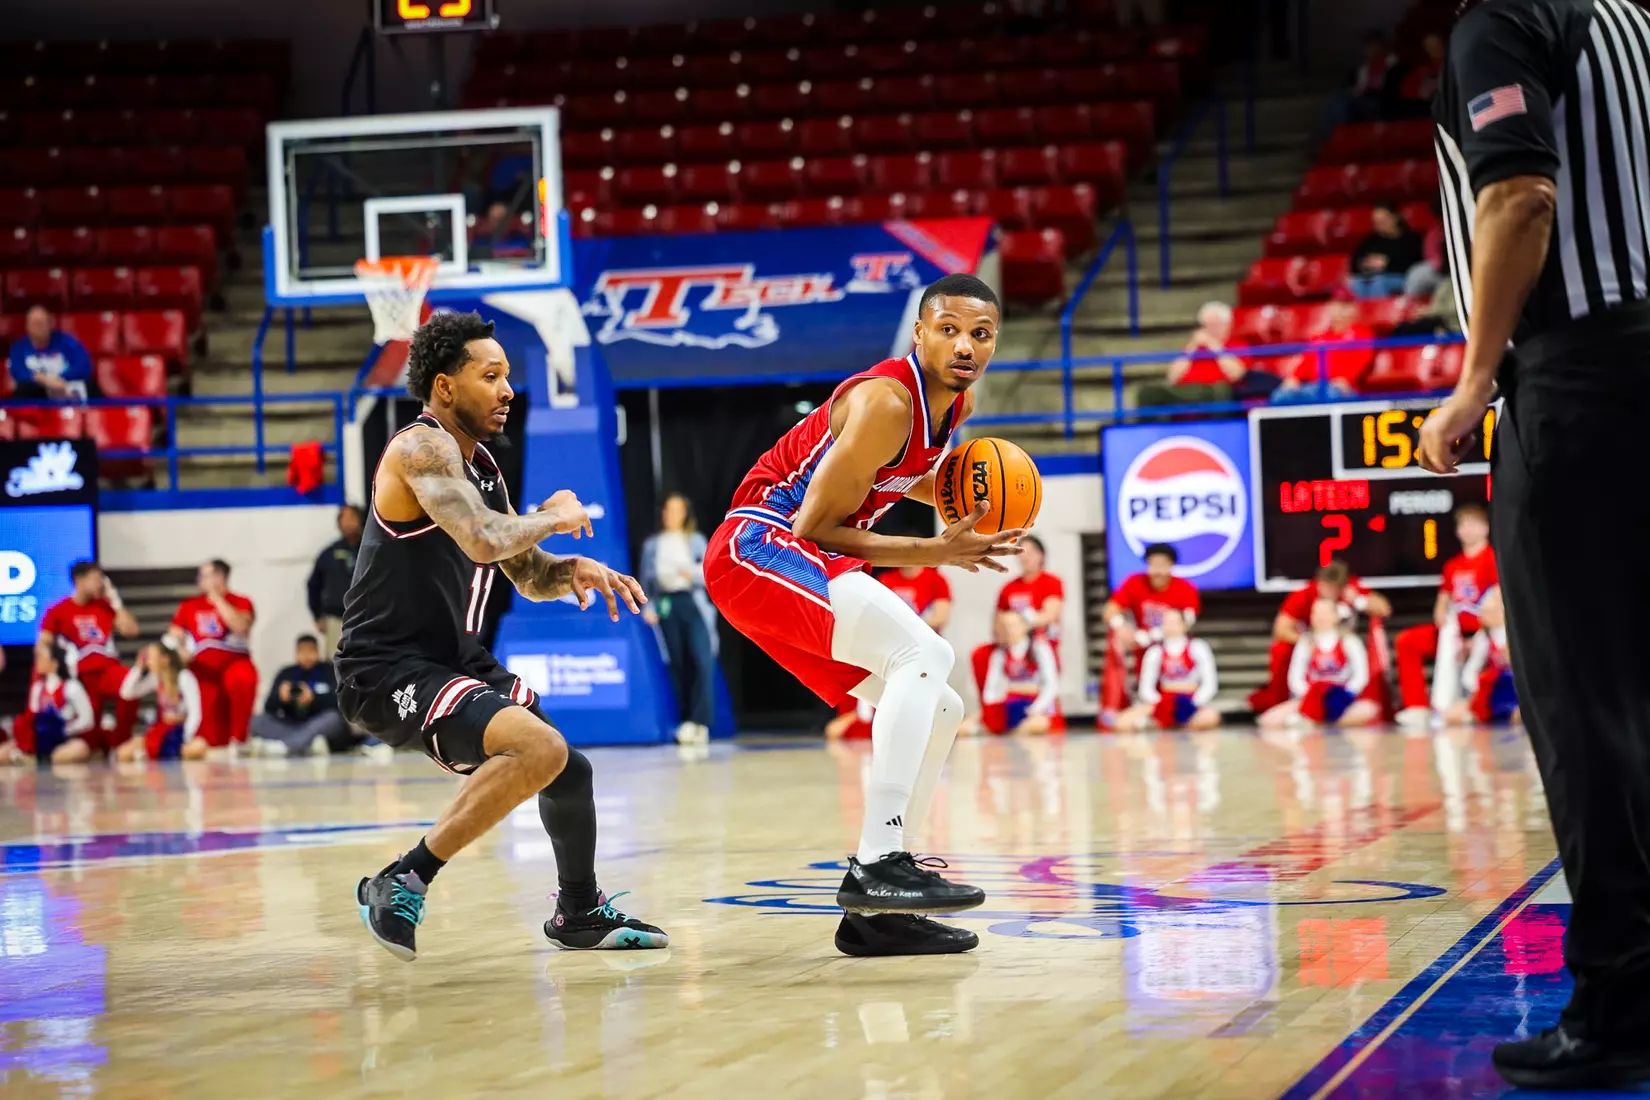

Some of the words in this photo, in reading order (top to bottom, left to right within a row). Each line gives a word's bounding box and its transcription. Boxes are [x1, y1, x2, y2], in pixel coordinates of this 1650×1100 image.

[940, 454, 962, 525] Wilson
[1130, 493, 1237, 522] PEPSI
[1319, 514, 1352, 568] 2
[1424, 519, 1438, 560] 1
[0, 596, 38, 623] ES
[463, 564, 496, 635] 11
